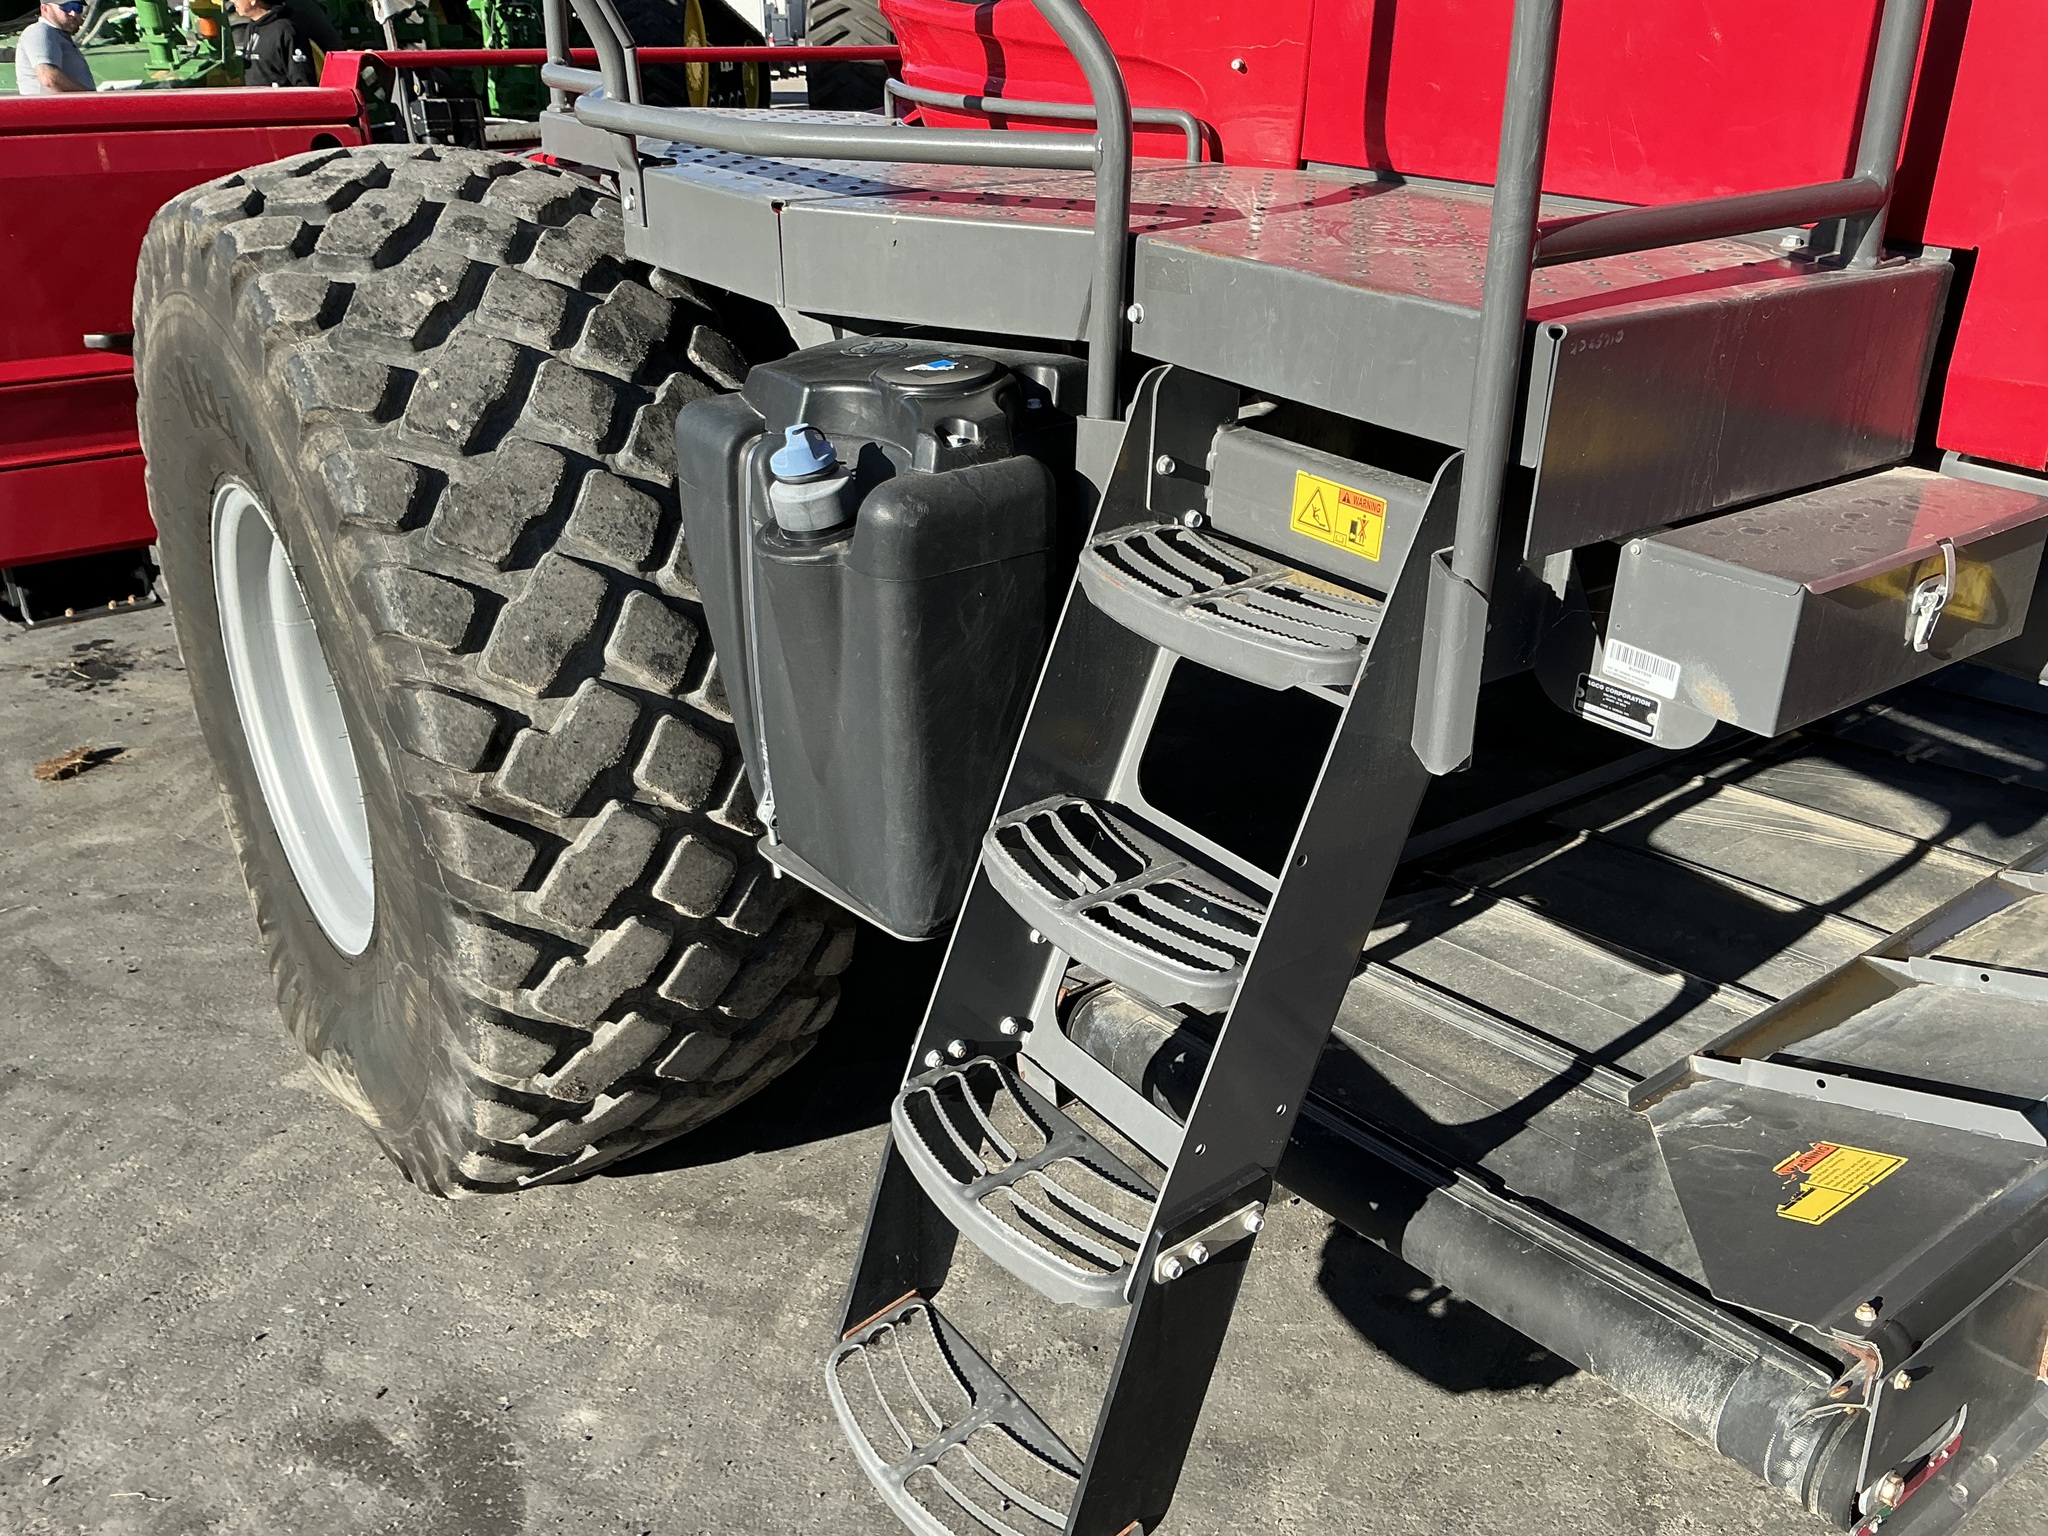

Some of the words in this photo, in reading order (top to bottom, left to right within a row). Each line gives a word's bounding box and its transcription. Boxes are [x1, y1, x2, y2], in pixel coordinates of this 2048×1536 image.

[1353, 495, 1381, 513] WARNING
[1588, 680, 1604, 690] AGCO
[1605, 687, 1651, 707] CORPORATION
